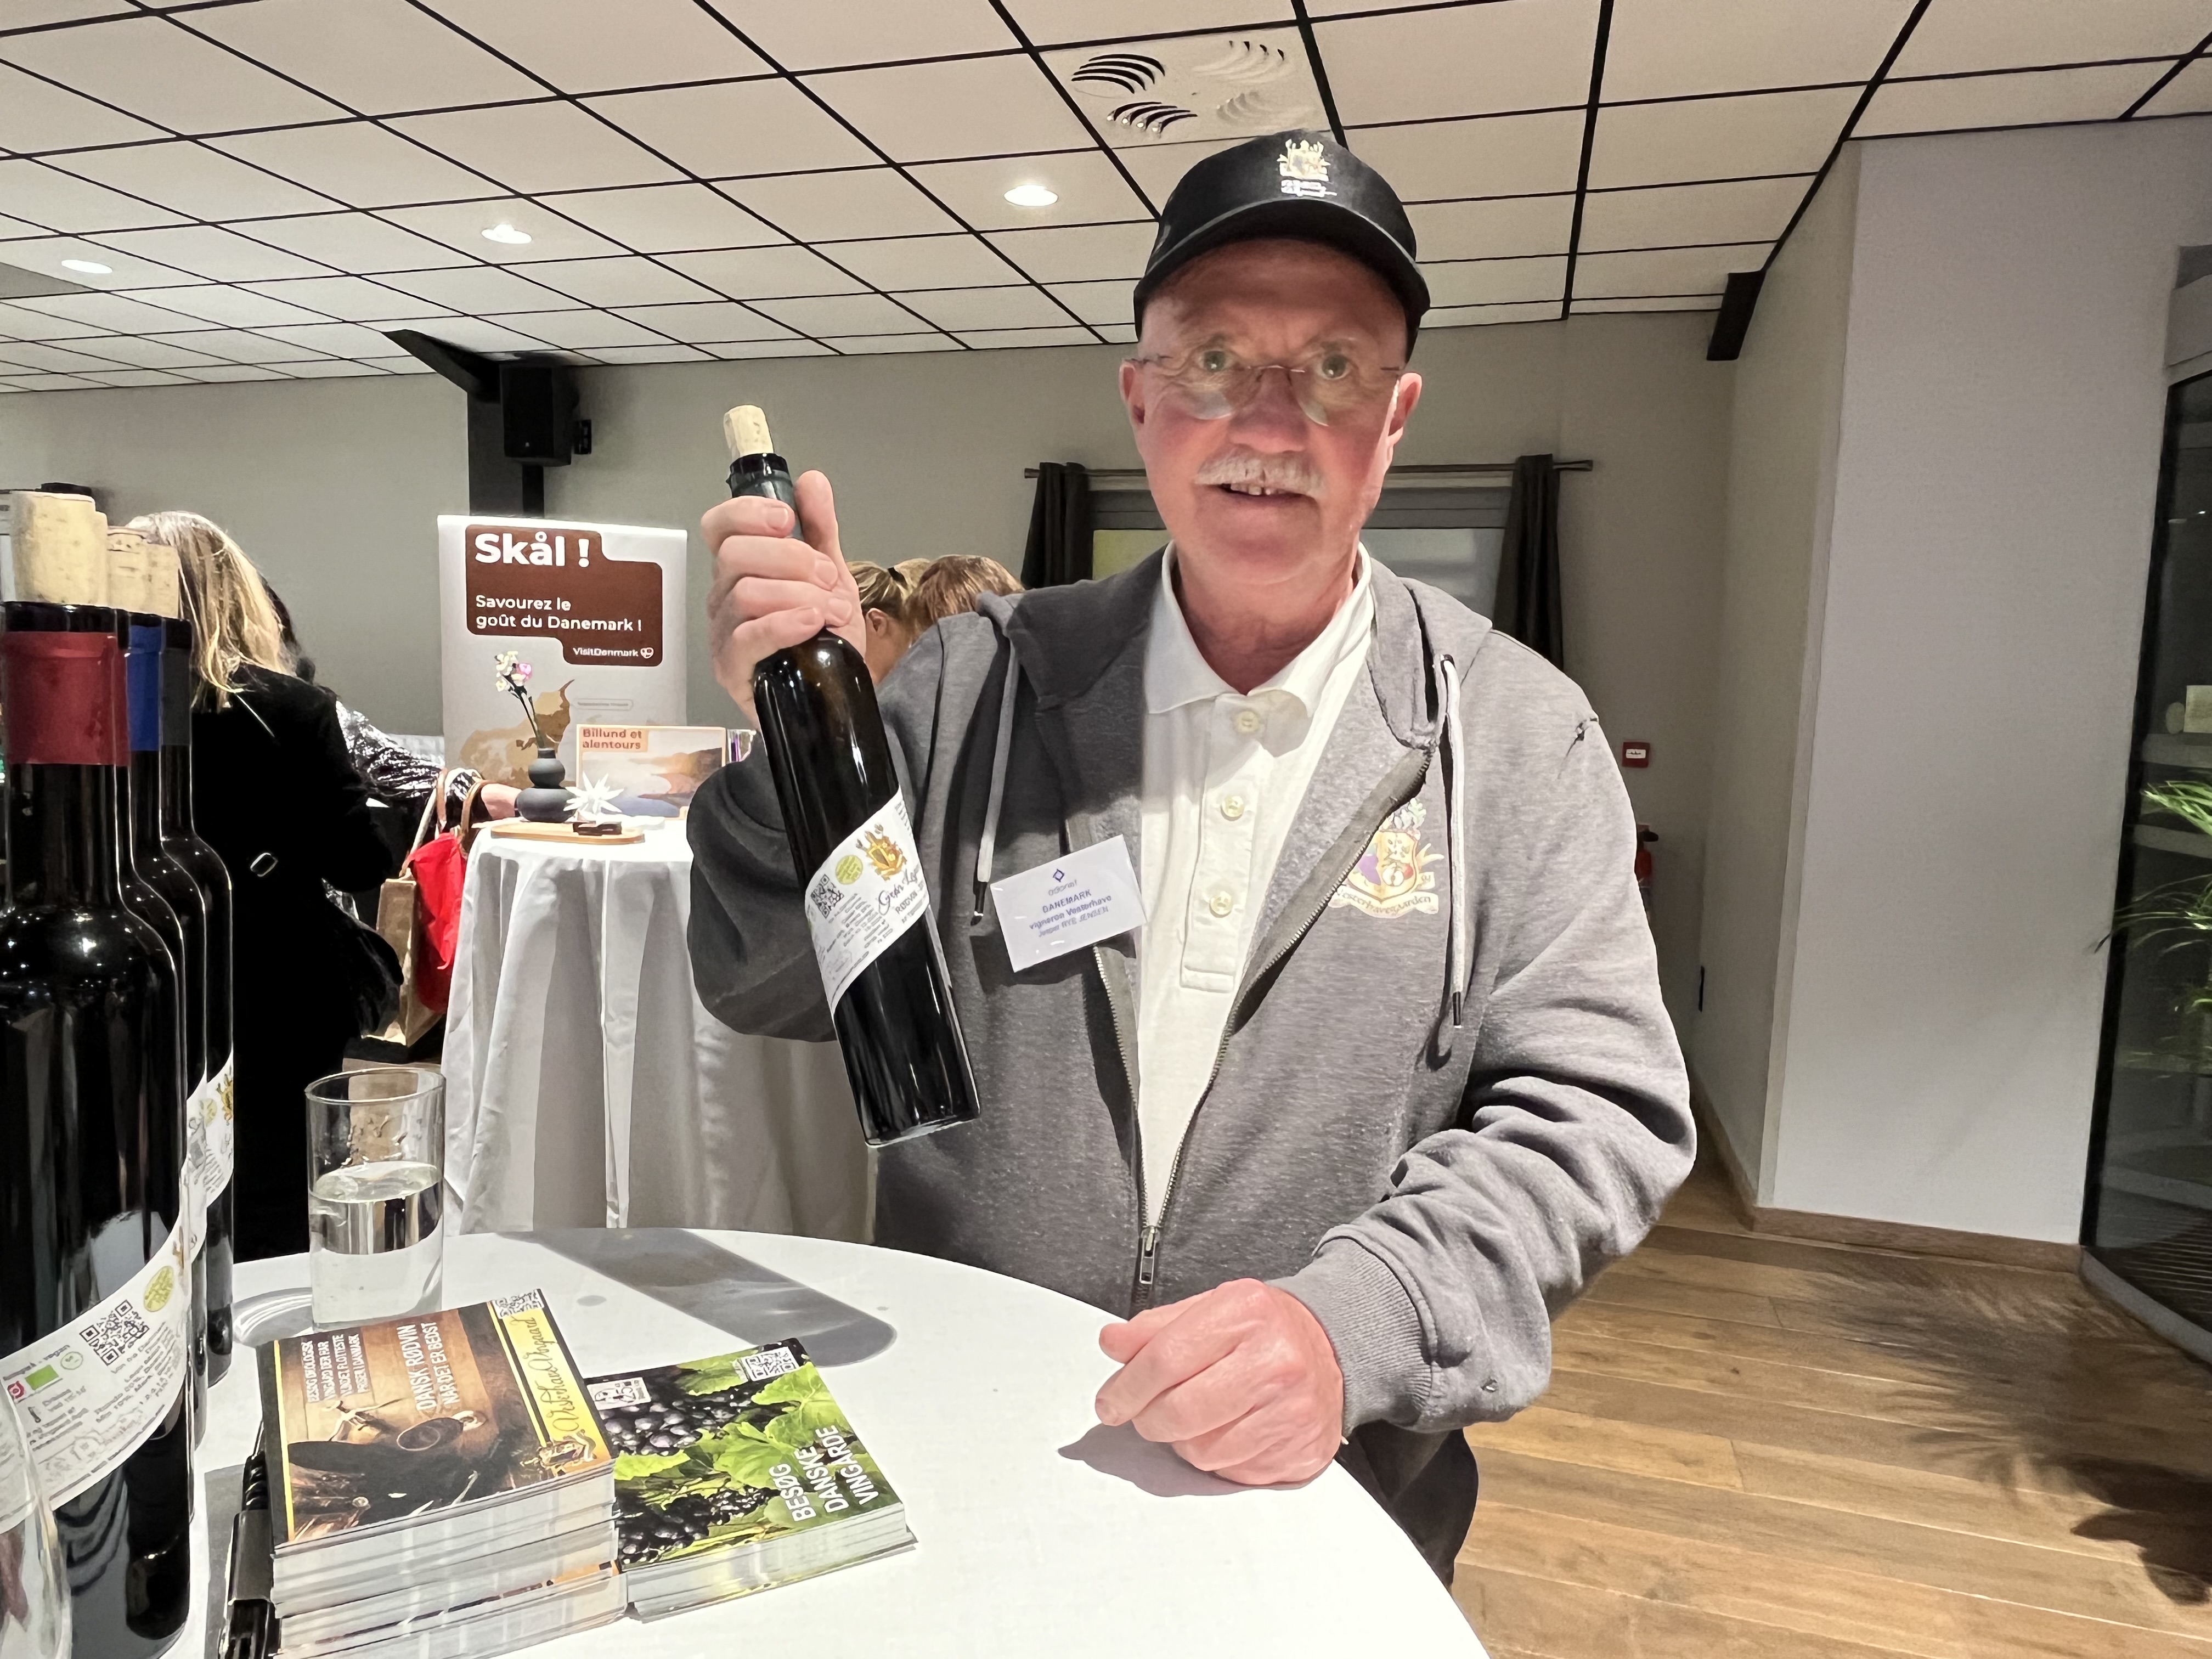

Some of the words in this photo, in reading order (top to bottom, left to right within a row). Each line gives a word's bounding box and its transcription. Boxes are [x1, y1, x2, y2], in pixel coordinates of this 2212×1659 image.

[475, 531, 565, 566] Skål
[578, 539, 589, 568] !
[476, 595, 552, 610] Savourez
[557, 597, 571, 611] le
[476, 614, 516, 629] goût
[521, 614, 543, 628] du
[548, 616, 634, 631] Danemark
[637, 619, 641, 631] !
[573, 647, 639, 657] VisitDenmark
[583, 728, 627, 738] Billund
[630, 730, 642, 738] et
[1042, 889, 1092, 913] DANEMARK
[397, 1324, 425, 1367] RØDVIN
[420, 1322, 443, 1350] BEDST
[430, 1350, 447, 1364] ER
[433, 1365, 454, 1384] DET
[408, 1368, 437, 1410] DANSK
[794, 1446, 849, 1513] DANSKE
[769, 1464, 816, 1521] BESØG
